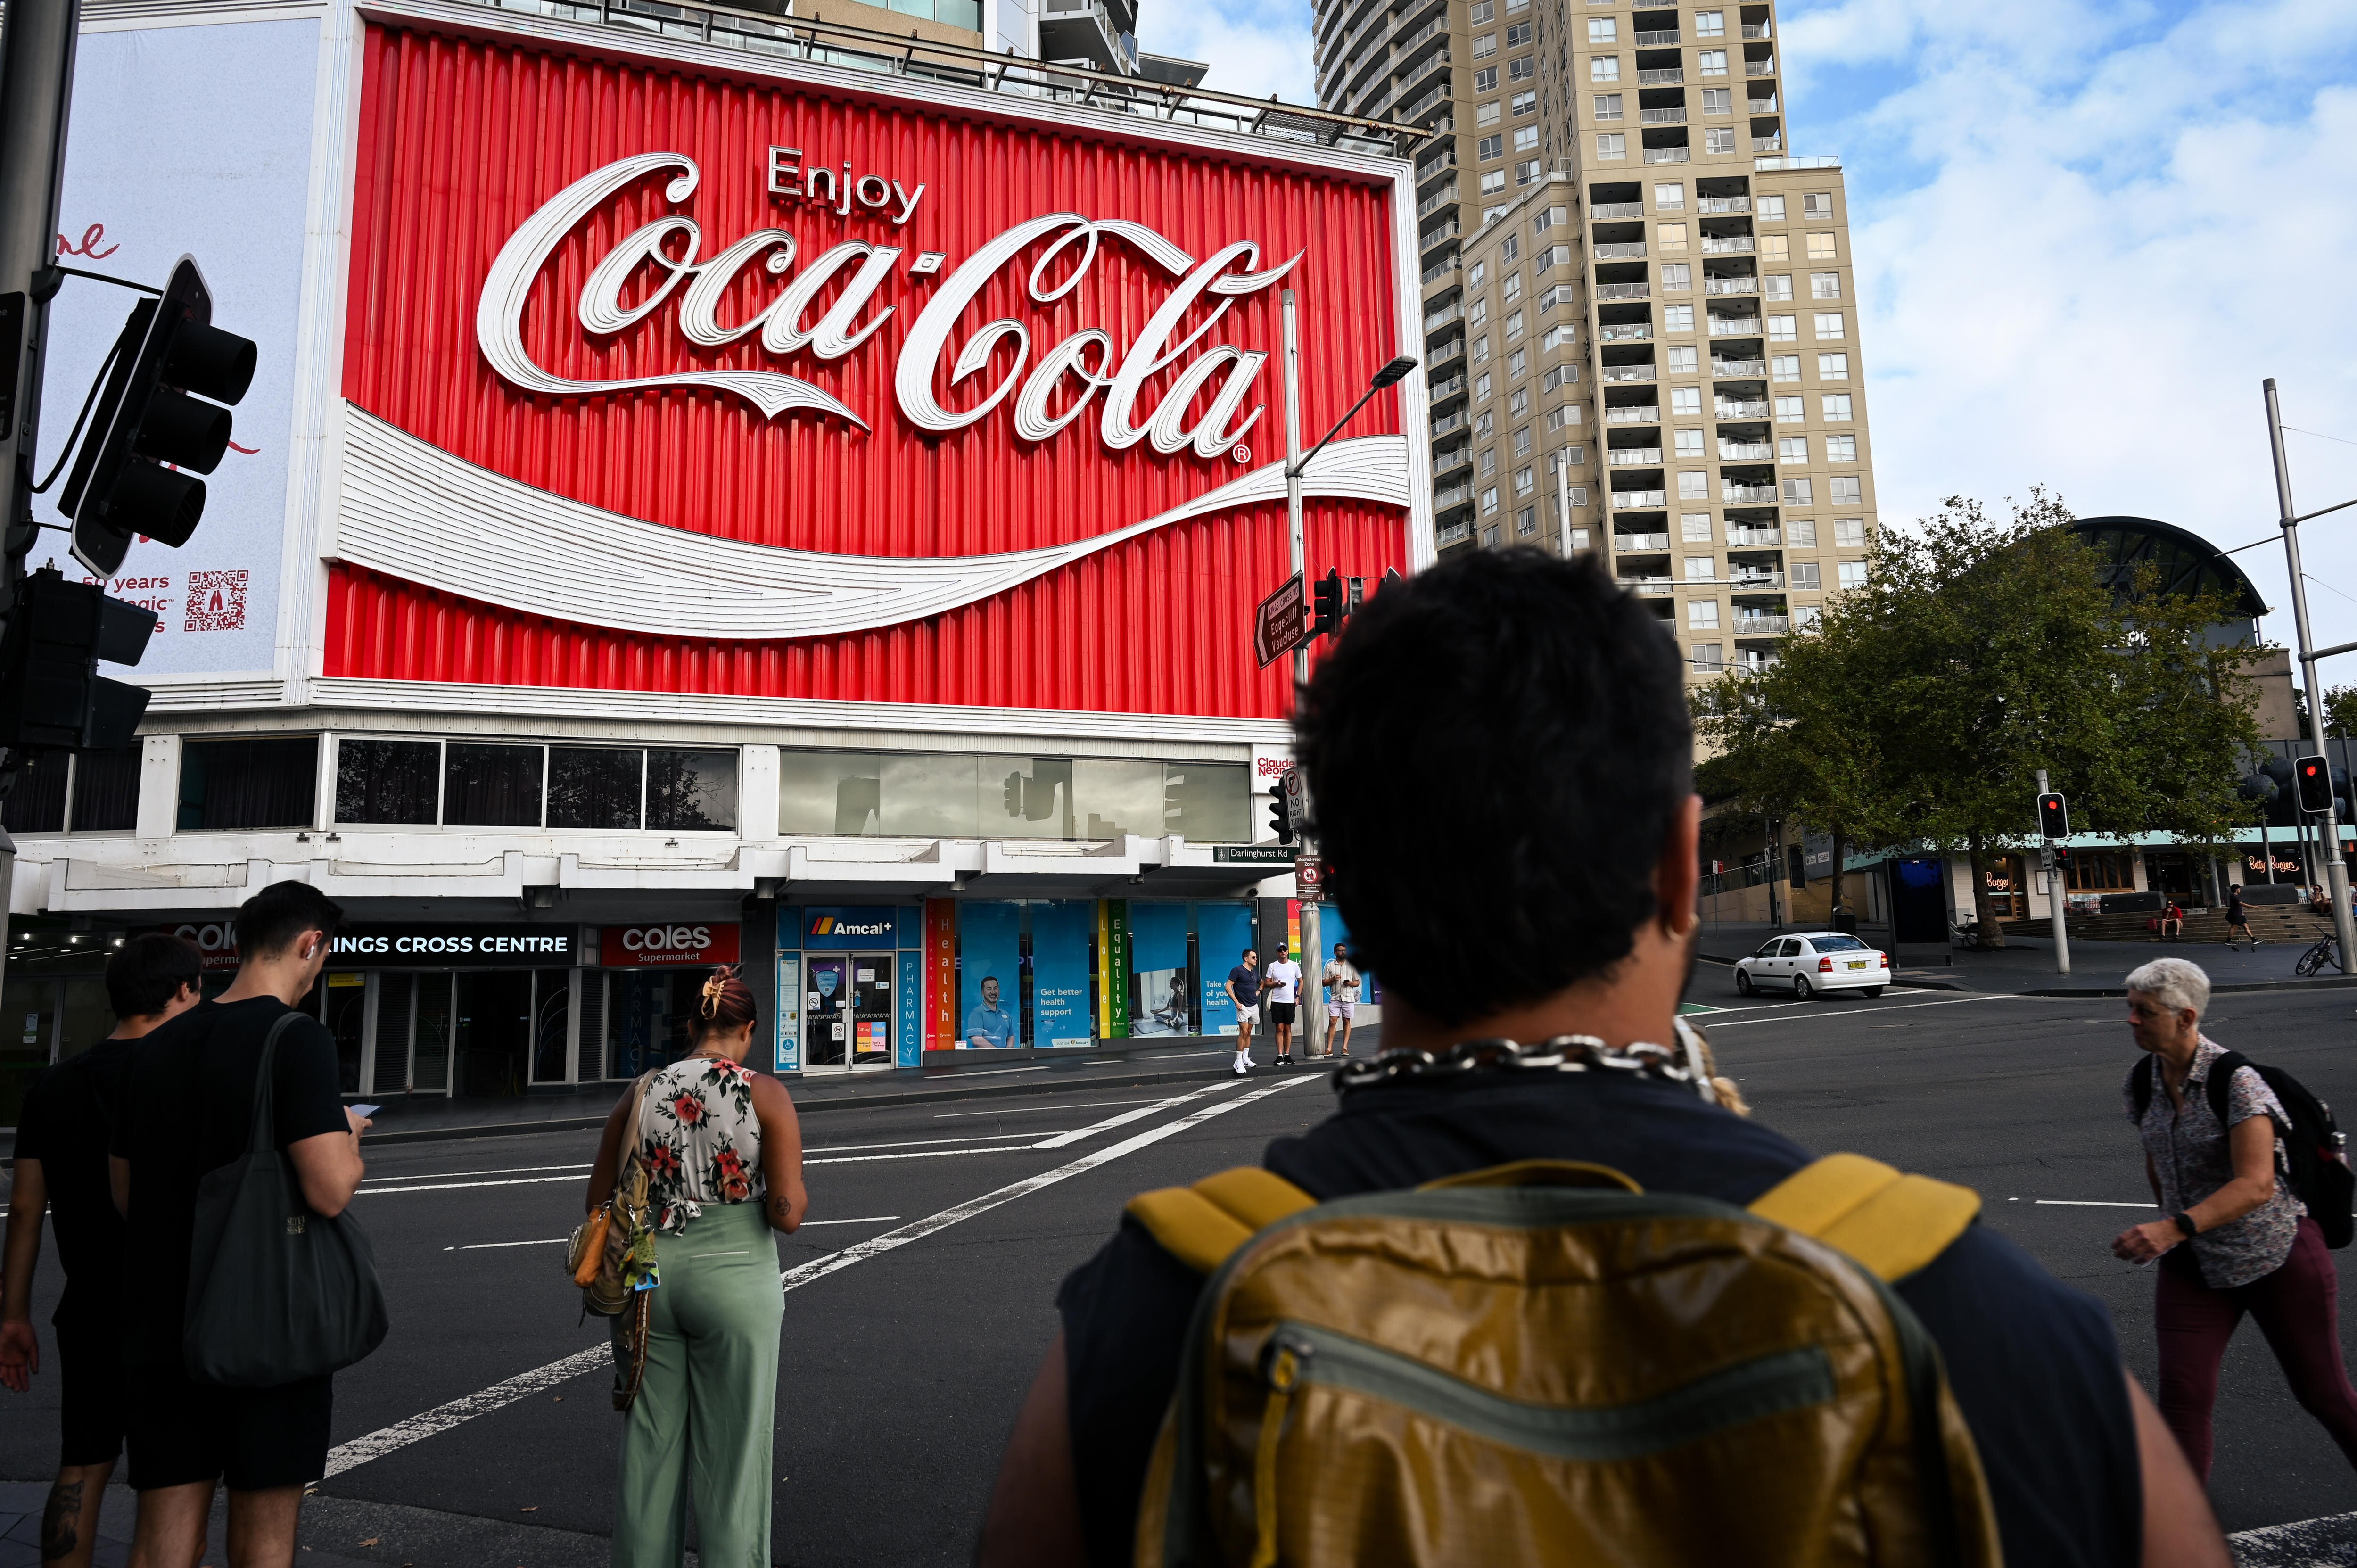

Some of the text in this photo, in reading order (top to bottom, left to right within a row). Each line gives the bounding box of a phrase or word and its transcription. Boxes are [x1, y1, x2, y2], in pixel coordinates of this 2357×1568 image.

[768, 144, 926, 224] Enjoy
[476, 151, 1306, 460] Coca-Cola
[114, 577, 169, 593] years
[1268, 586, 1298, 616] KINGS CROSS RD
[1271, 605, 1297, 636] Edgecliff
[1272, 626, 1298, 652] Vaucluse
[1257, 757, 1295, 768] Claude
[1290, 798, 1300, 808] NO
[1290, 809, 1302, 817] RIGHT
[1291, 818, 1302, 826] TURN
[1231, 849, 1287, 859] Darlinghurst Rd
[2248, 855, 2300, 873] Betty Burgers
[1986, 871, 2009, 890] Burger
[329, 936, 568, 953] INGS CROSS CENTRE
[623, 925, 712, 951] coles
[638, 951, 700, 963] Supermarket
[941, 919, 949, 1022] Health
[1057, 988, 1082, 996] better
[905, 962, 914, 1057] PHARMACY
[1040, 998, 1065, 1006] health
[1040, 1008, 1072, 1017] support
[630, 970, 642, 1078] HARMACY
